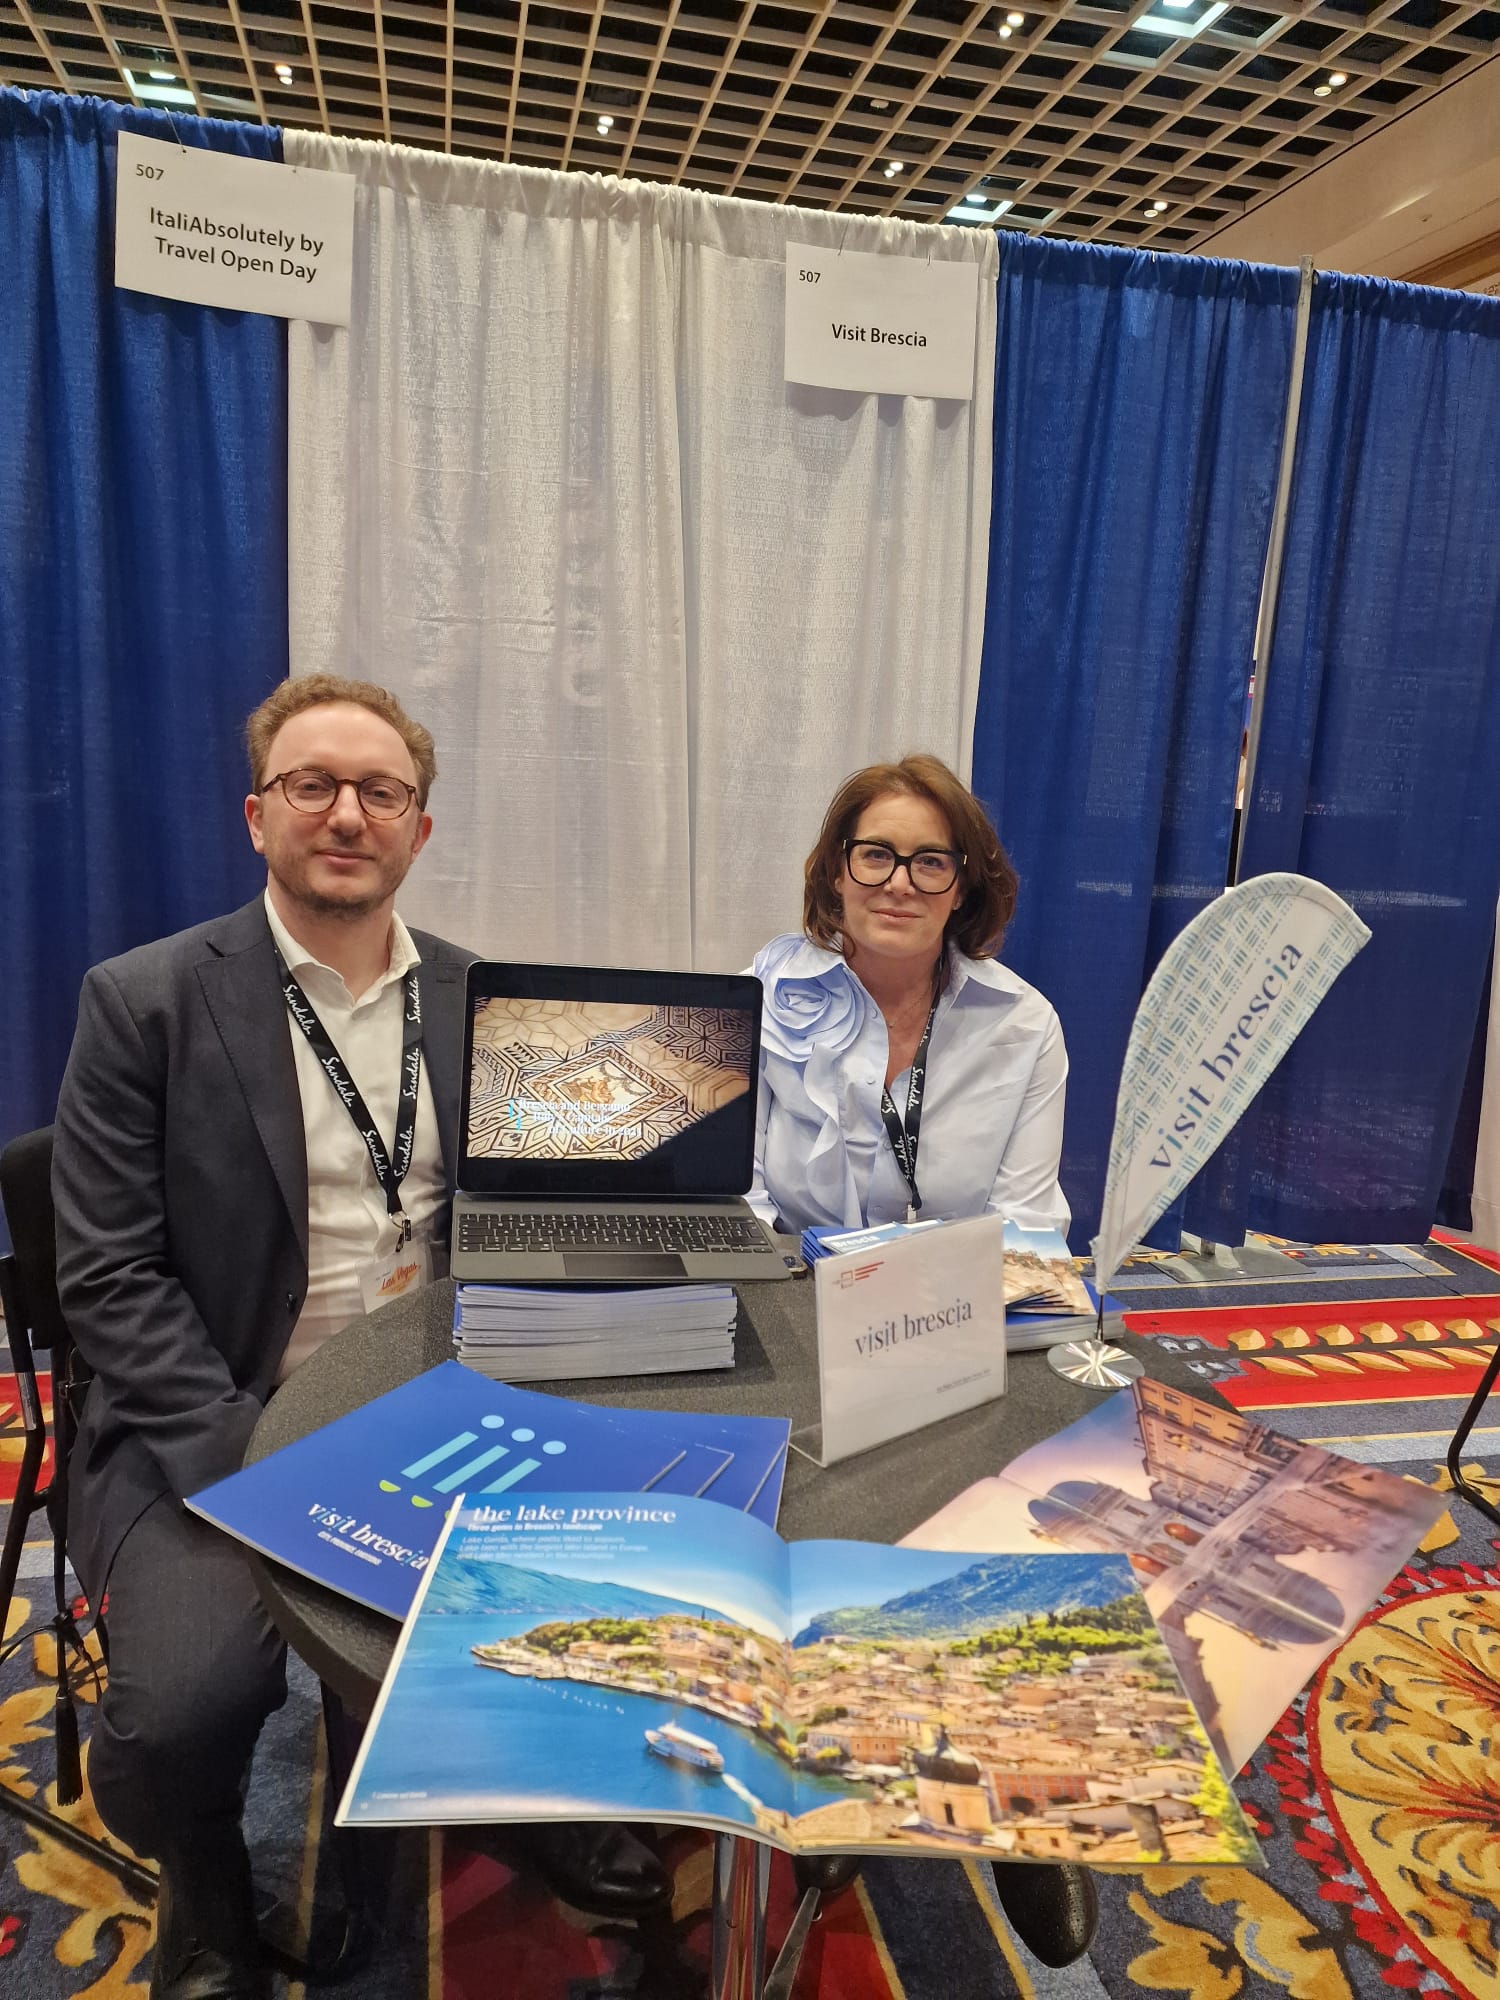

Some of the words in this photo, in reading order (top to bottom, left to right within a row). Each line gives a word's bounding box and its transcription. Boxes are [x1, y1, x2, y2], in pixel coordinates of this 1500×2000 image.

[136, 164, 164, 181] 507
[150, 206, 295, 252] ItaliAbsolutely
[300, 233, 324, 257] by
[155, 236, 215, 264] Travel
[221, 249, 274, 273] Open
[280, 259, 317, 284] Day
[799, 270, 821, 284] 507
[831, 323, 866, 342] Visit
[870, 327, 927, 347] Brescia
[283, 984, 311, 1036] Sandals
[407, 976, 421, 1024] Sandals
[321, 1056, 353, 1108] Sandals
[402, 1047, 419, 1100] Sandals
[1149, 1083, 1211, 1172] visit
[1200, 942, 1304, 1082] brescia
[907, 1066, 924, 1111] Sandals
[362, 1129, 384, 1181] Sandals
[394, 1125, 413, 1179] Sandals
[855, 1321, 898, 1358] visit
[903, 1298, 972, 1340] brescia
[308, 1503, 357, 1534] visit
[350, 1523, 430, 1570] brescia
[472, 1504, 511, 1522] the
[516, 1504, 565, 1522] lake
[571, 1505, 677, 1524] province
